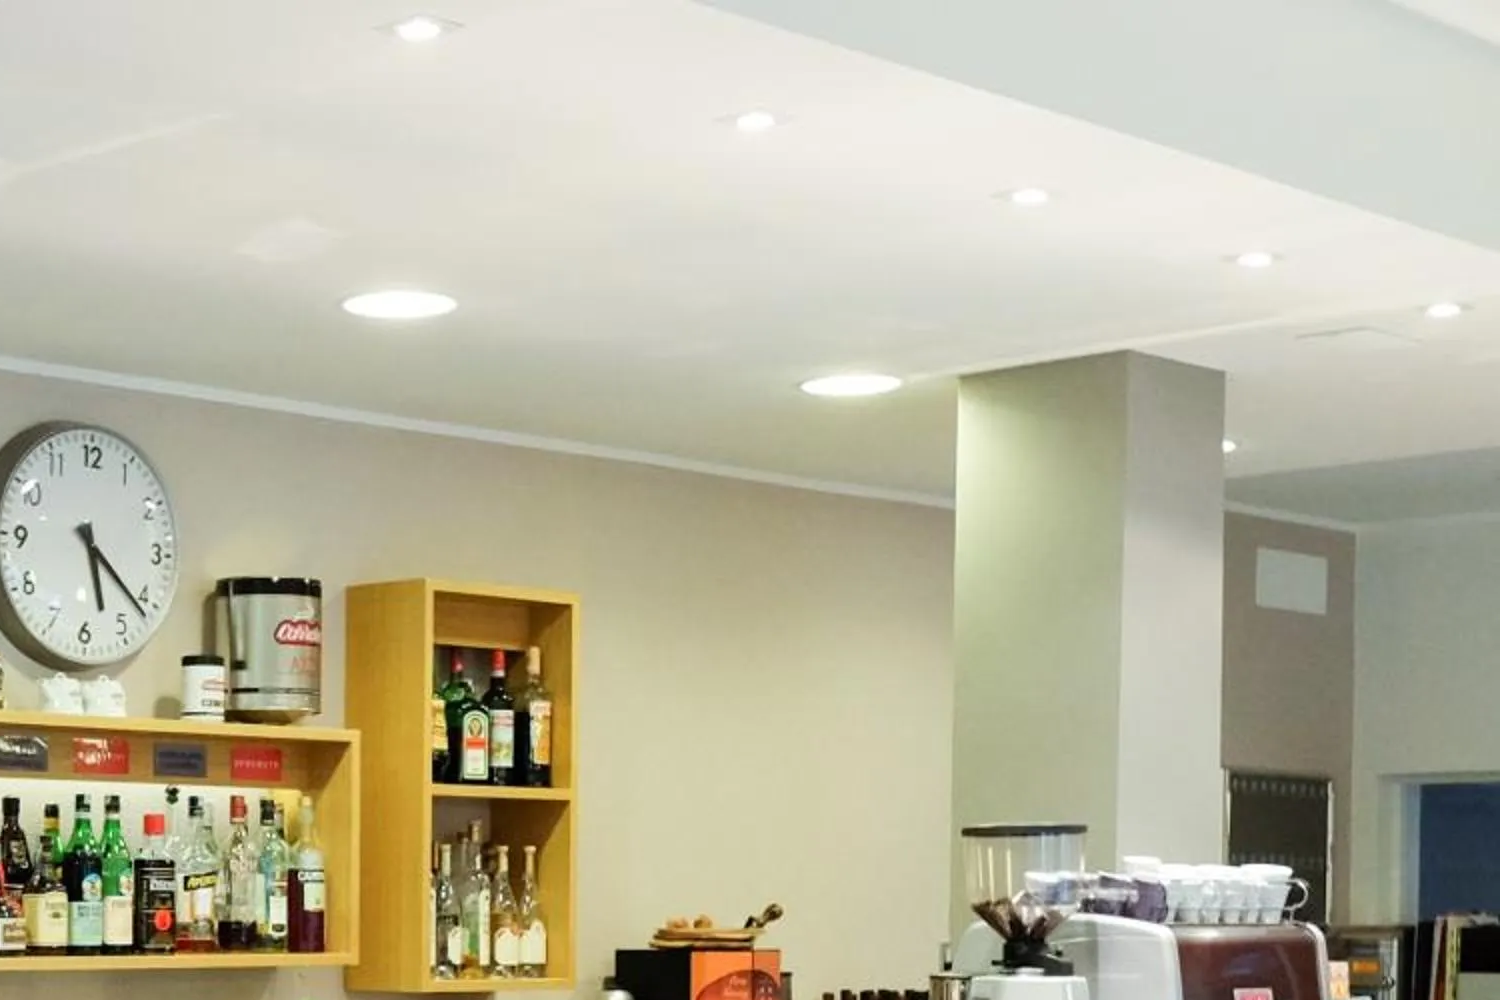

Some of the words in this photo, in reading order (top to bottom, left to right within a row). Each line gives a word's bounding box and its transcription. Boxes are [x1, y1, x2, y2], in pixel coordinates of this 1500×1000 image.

[49, 453, 64, 477] 11
[83, 444, 103, 469] 12
[122, 463, 128, 486] 1
[143, 496, 157, 521] 2
[13, 524, 29, 549] 9
[150, 543, 163, 566] 3
[138, 585, 150, 604] 4
[48, 605, 62, 628] 7
[115, 612, 128, 636] 5
[77, 621, 92, 644] 6
